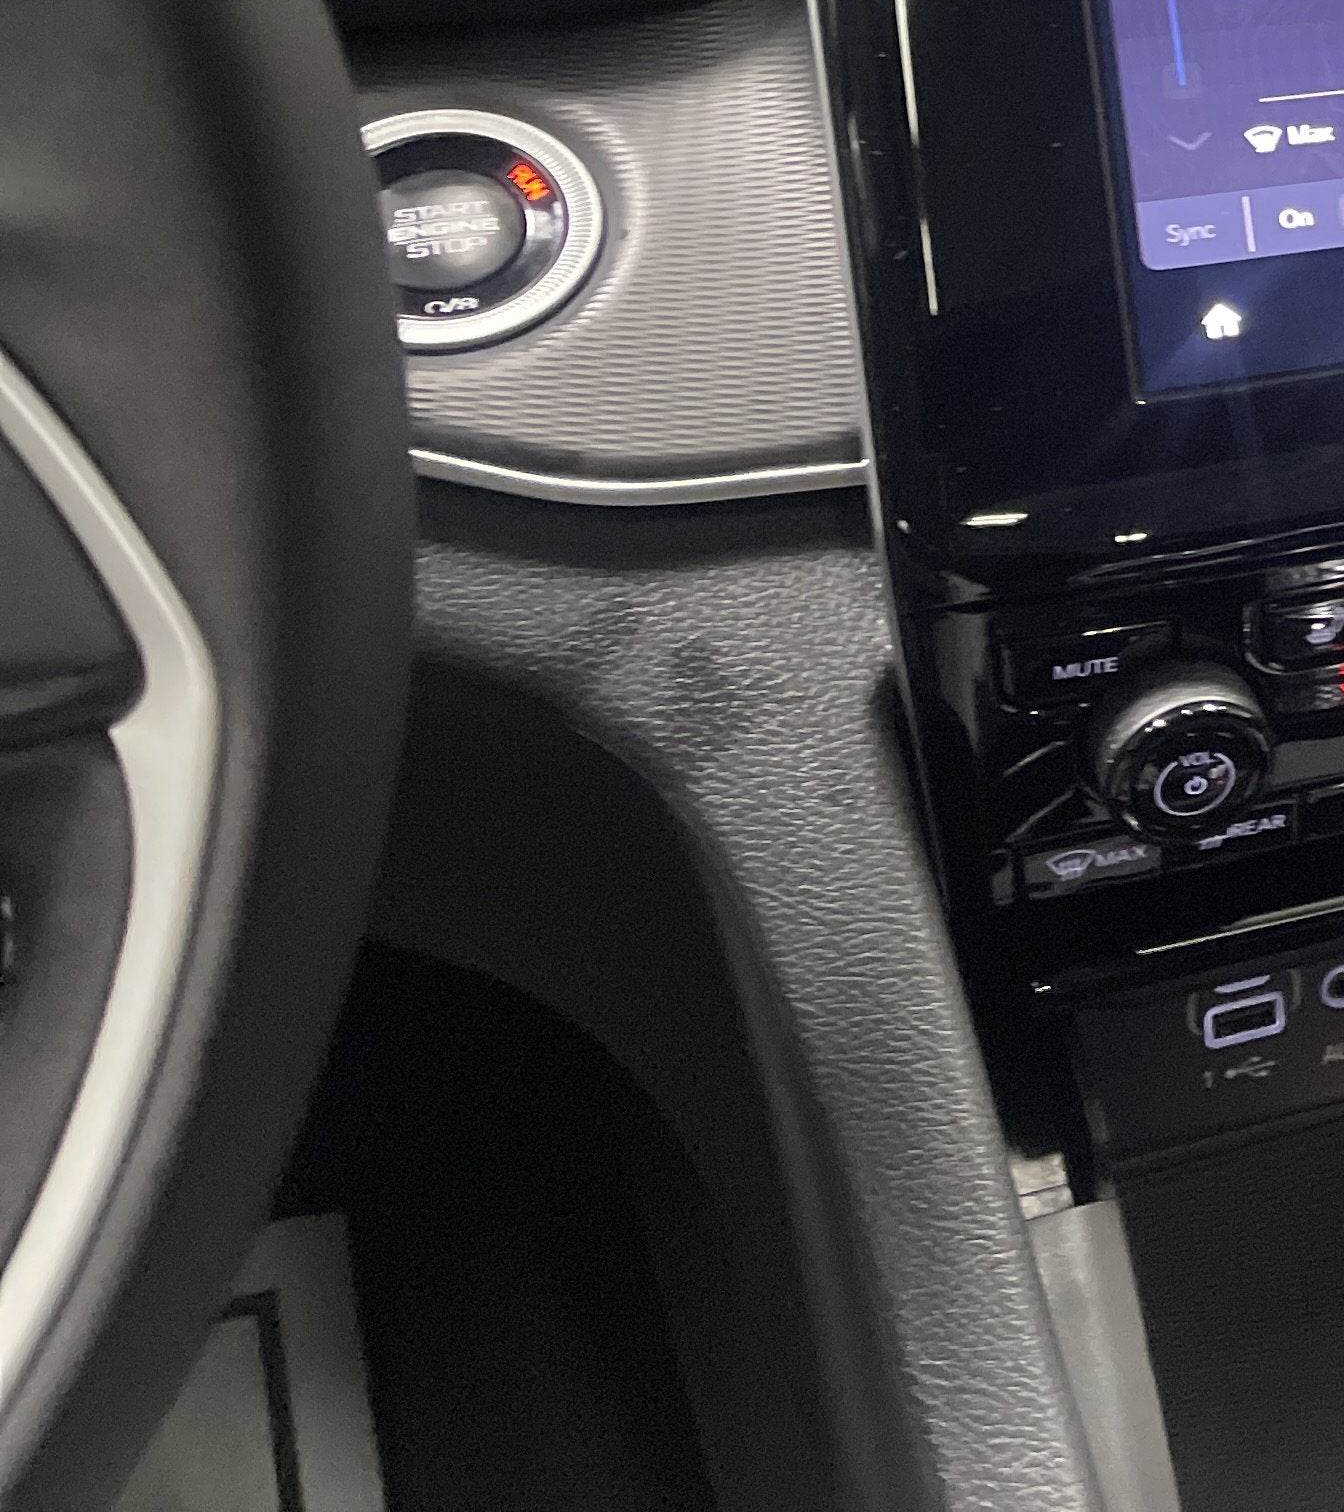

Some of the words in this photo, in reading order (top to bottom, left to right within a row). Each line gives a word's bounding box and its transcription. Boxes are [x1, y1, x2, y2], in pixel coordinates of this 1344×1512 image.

[394, 201, 488, 223] START
[1278, 208, 1316, 229] On
[387, 218, 500, 243] ENGINE
[1165, 221, 1217, 247] Sync
[406, 237, 487, 259] STOP
[1052, 656, 1119, 681] MUTE
[1227, 814, 1287, 838] REAR
[1095, 844, 1147, 868] MAX
